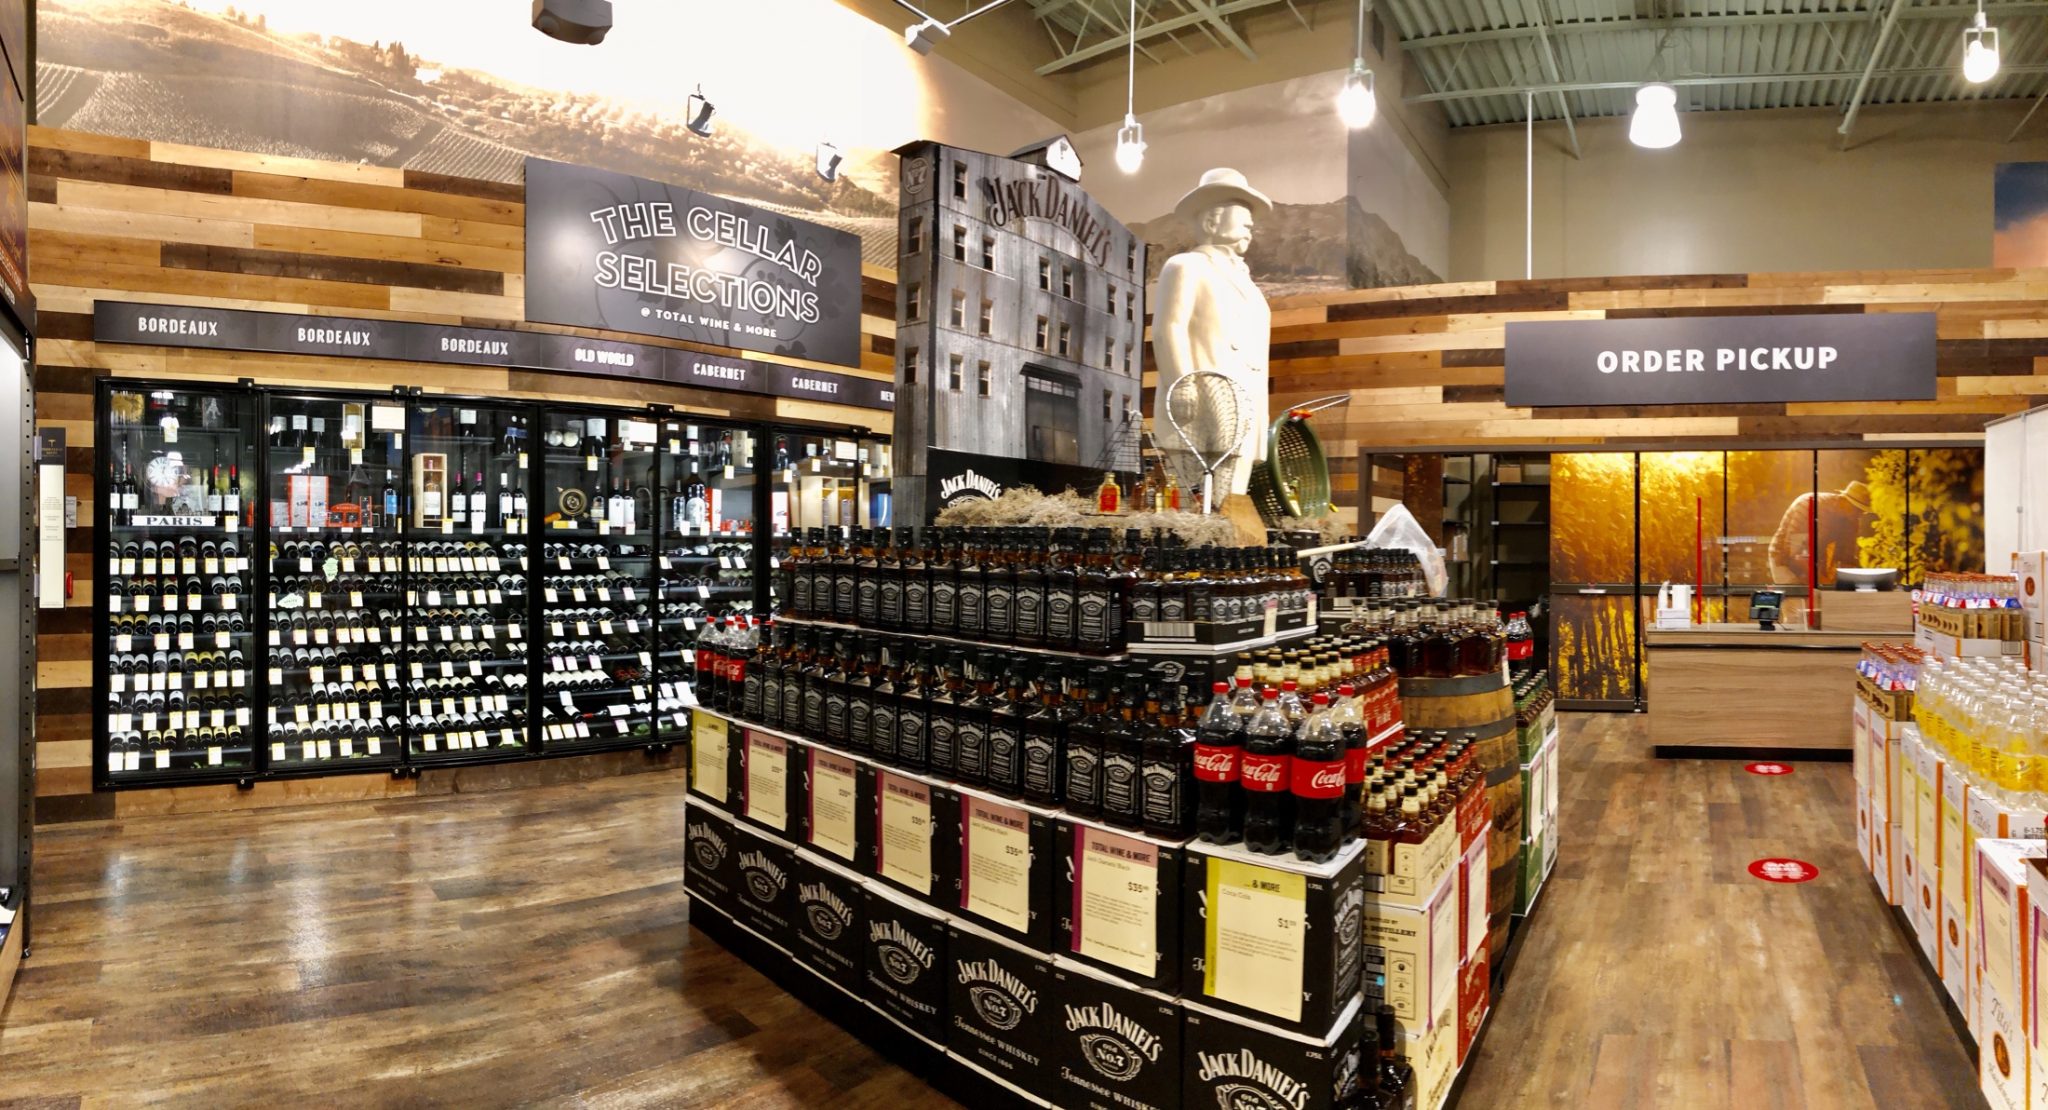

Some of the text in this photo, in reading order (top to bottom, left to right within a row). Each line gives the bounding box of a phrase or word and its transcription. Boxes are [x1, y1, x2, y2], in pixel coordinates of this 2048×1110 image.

[992, 174, 1112, 268] JACK DANIEL'S
[590, 202, 822, 288] THE CELLAR
[594, 251, 820, 324] SELECTIONS
[138, 316, 218, 336] BORDEAUX
[655, 309, 695, 324] TOTAL
[699, 316, 730, 330] WINE
[733, 323, 742, 332] &
[745, 325, 777, 338] MORE
[298, 327, 371, 346] BORDEAUX
[441, 337, 508, 355] BORDEAUX
[575, 348, 634, 367] OLD WORLD
[1597, 346, 1838, 374] ORDER PICKUP
[693, 362, 746, 381] CABERNET
[792, 377, 838, 394] CABERNET
[941, 474, 966, 499] JACK
[146, 516, 203, 526] PARIS
[975, 808, 989, 820] TOTAL
[991, 813, 1004, 823] WINE
[1009, 818, 1025, 829] MORE
[1091, 841, 1151, 862] TOTAL WINE & MORE
[1251, 879, 1281, 893] & MORE
[957, 958, 1039, 1014] JACK DANIEL'S
[1065, 1001, 1164, 1062] JACK DANIEL'S
[996, 1039, 1040, 1067] WHISKEY
[1198, 1048, 1311, 1110] JACK DANIEL'S
[1113, 1092, 1160, 1110] WHISK
